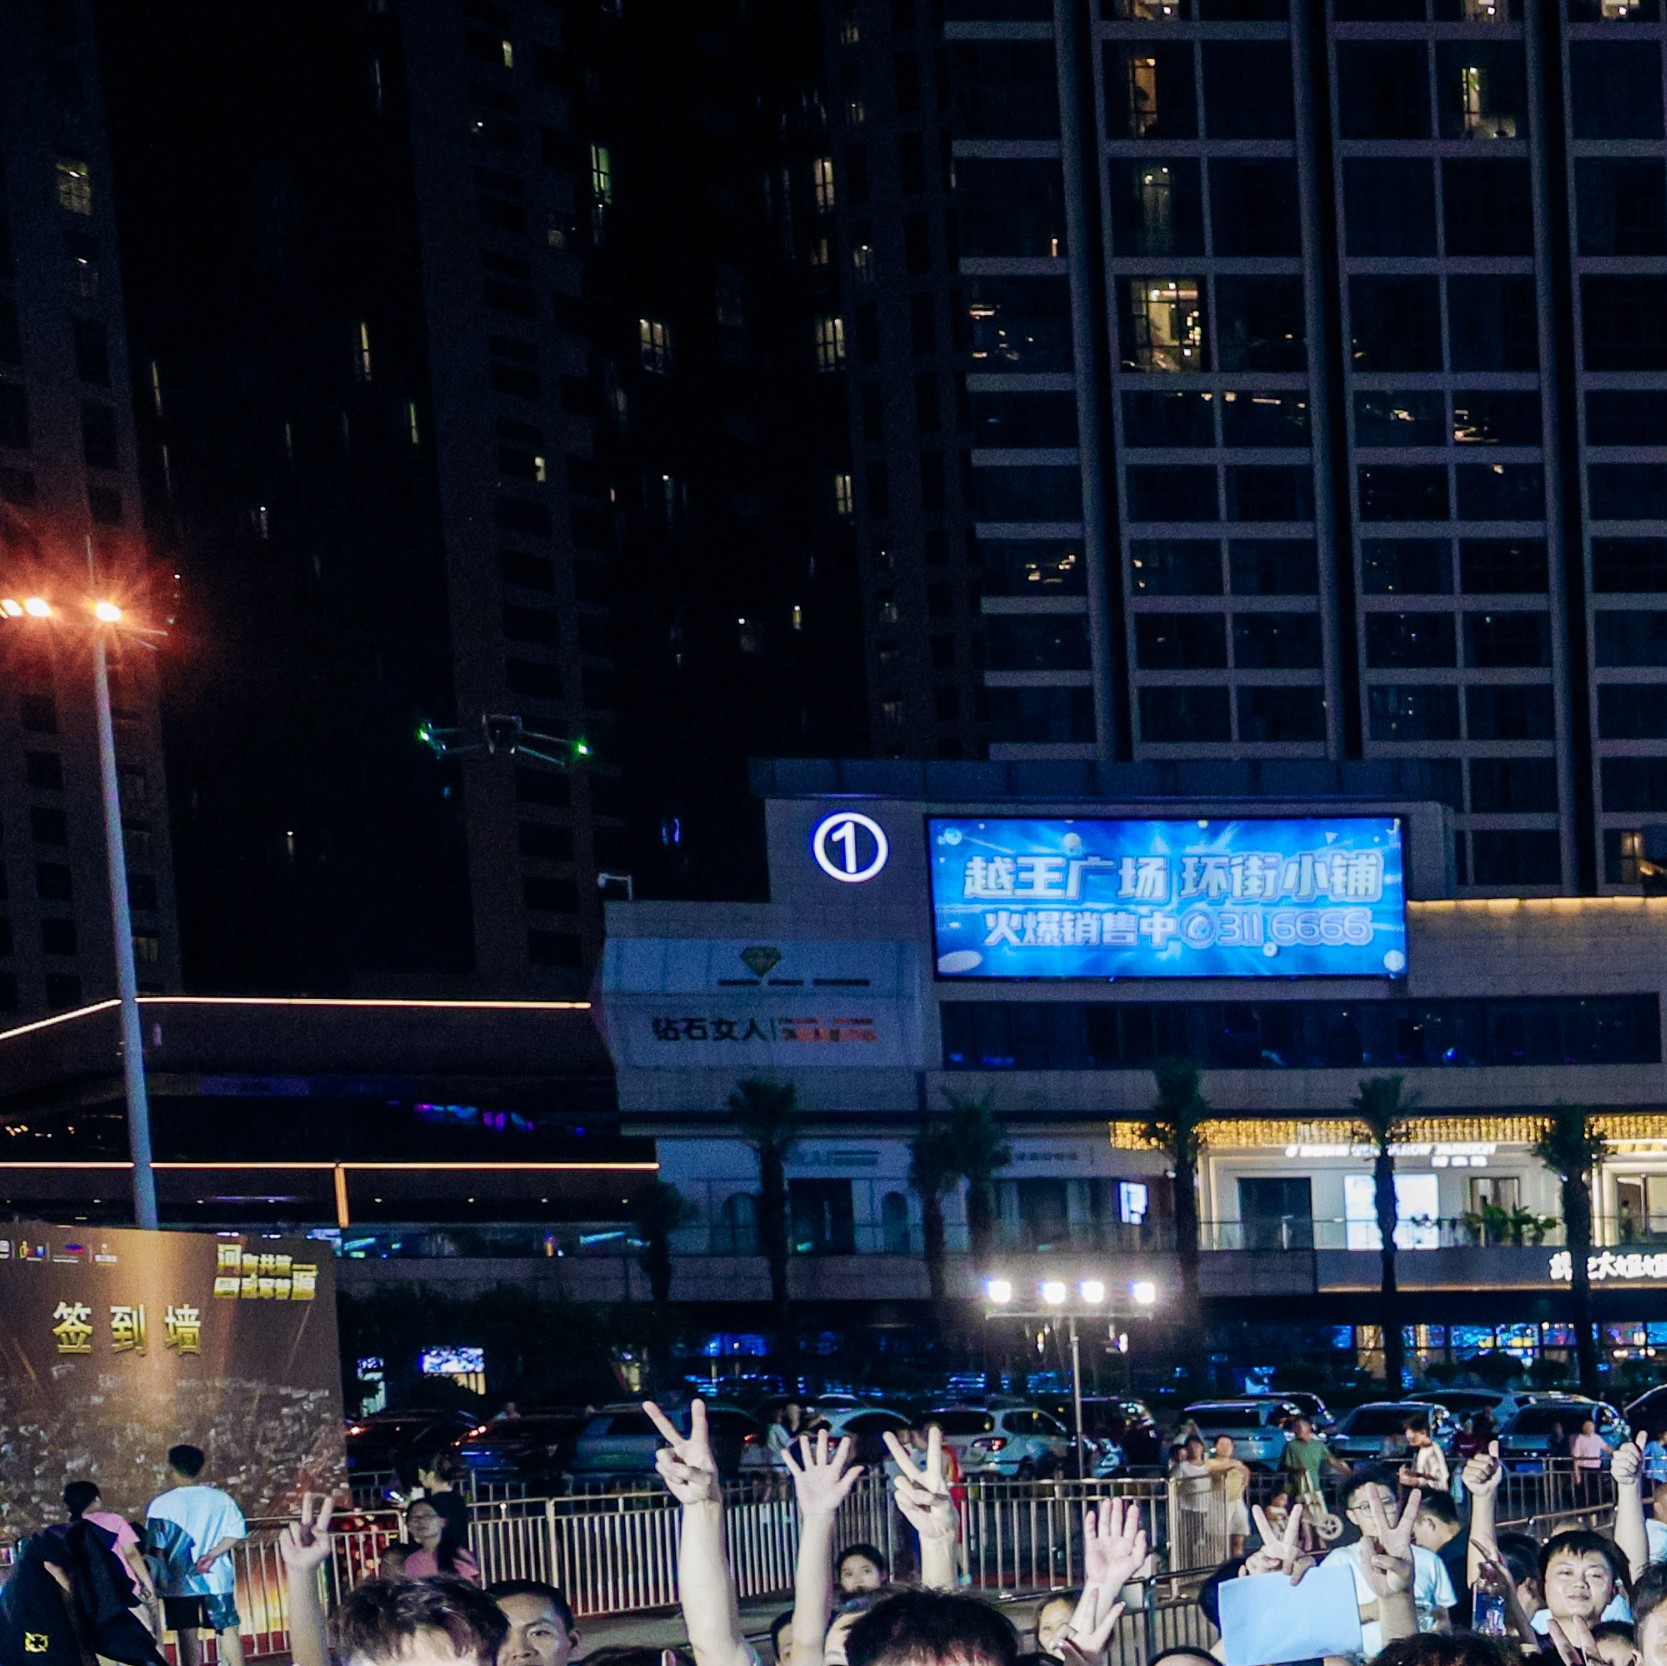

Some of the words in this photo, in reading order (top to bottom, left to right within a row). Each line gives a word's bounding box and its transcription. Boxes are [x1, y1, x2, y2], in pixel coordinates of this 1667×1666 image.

[963, 853, 1171, 901] 越王广场
[984, 910, 1177, 946] 火爆销售中
[652, 1016, 769, 1042] 钻石女人
[52, 1301, 202, 1357] 签到墙
